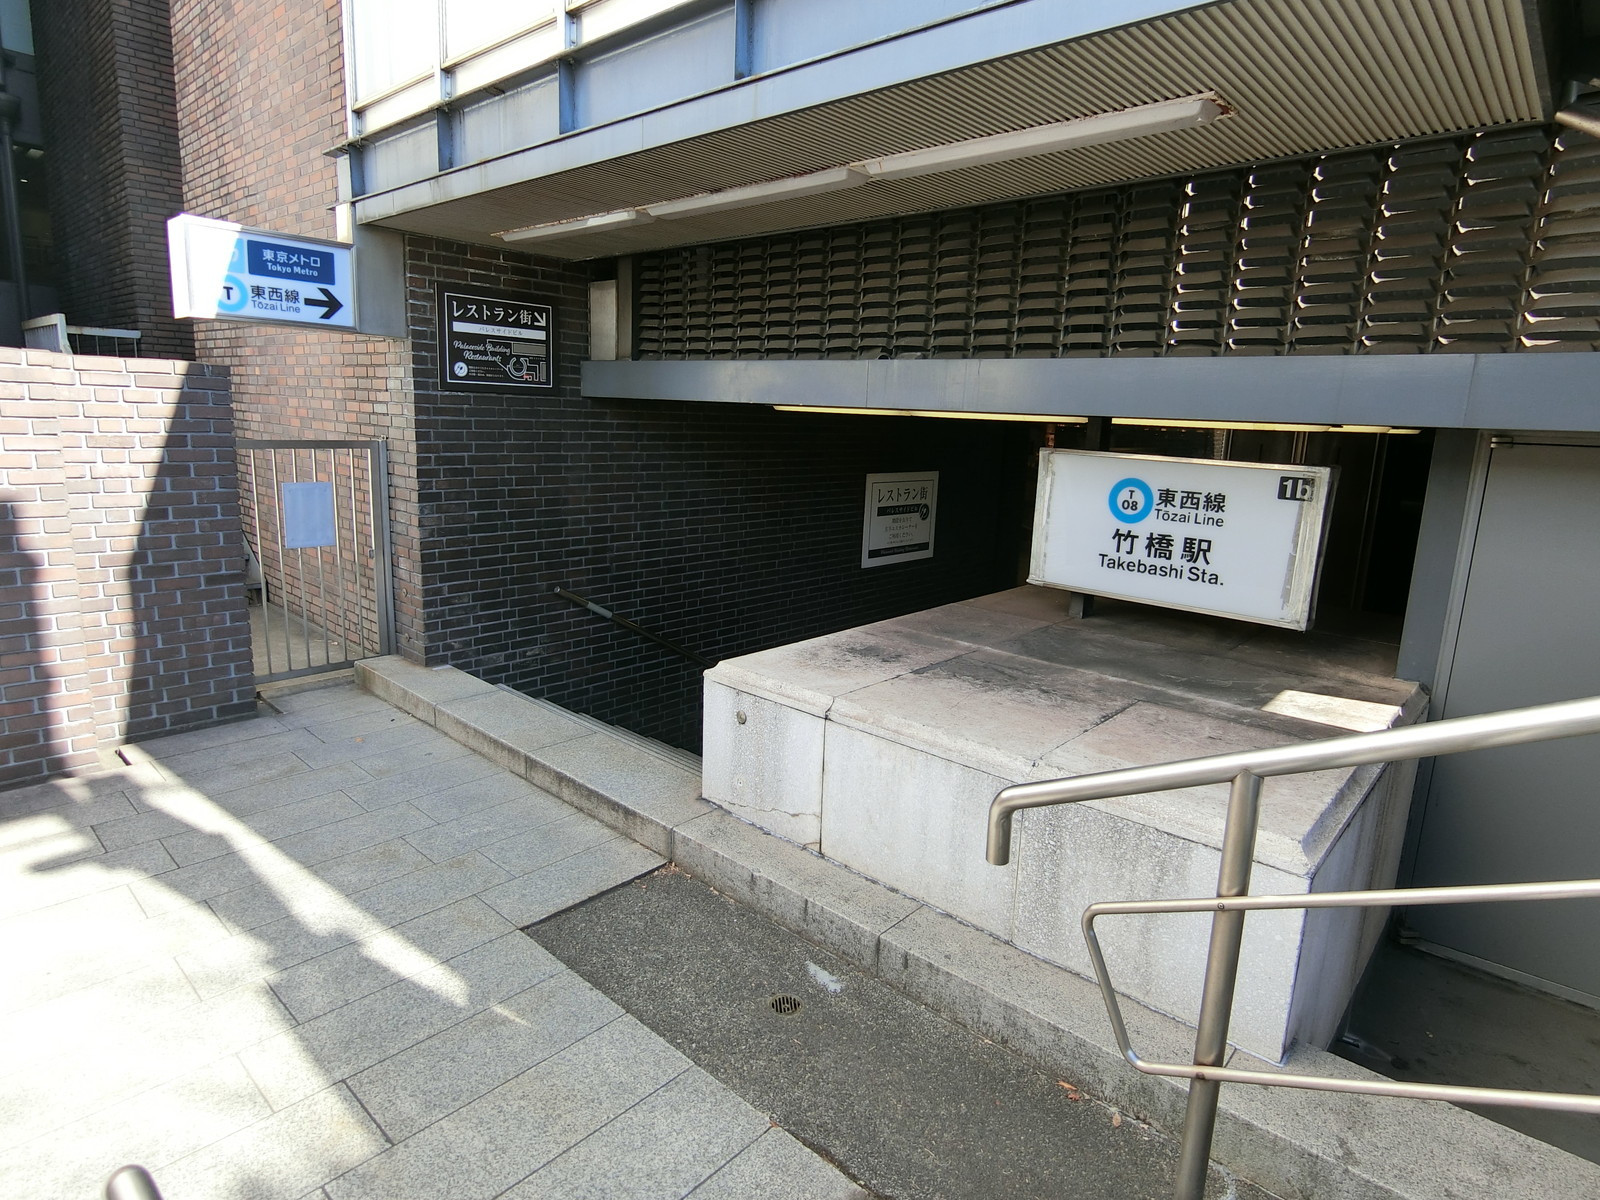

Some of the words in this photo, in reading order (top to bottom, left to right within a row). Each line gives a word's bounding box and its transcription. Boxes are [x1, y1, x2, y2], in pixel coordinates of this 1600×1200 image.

[262, 248, 321, 268] 東京メトロ
[266, 262, 292, 274] Tokyo
[293, 267, 319, 277] Metro
[223, 286, 233, 301] T
[250, 285, 300, 304] 東西線
[280, 304, 301, 314] Line
[452, 300, 532, 326] レストラン街
[877, 486, 928, 503] レストラン街
[1128, 489, 1136, 500] T
[1282, 479, 1312, 499] 1b
[1121, 500, 1138, 512] 08
[1155, 488, 1226, 513] 東西線
[1154, 508, 1191, 524] Tōzai
[1194, 512, 1224, 528] Line
[1112, 528, 1212, 566] 竹橋駅
[1098, 553, 1184, 580] Takebashi
[1187, 566, 1224, 586] Sta.
